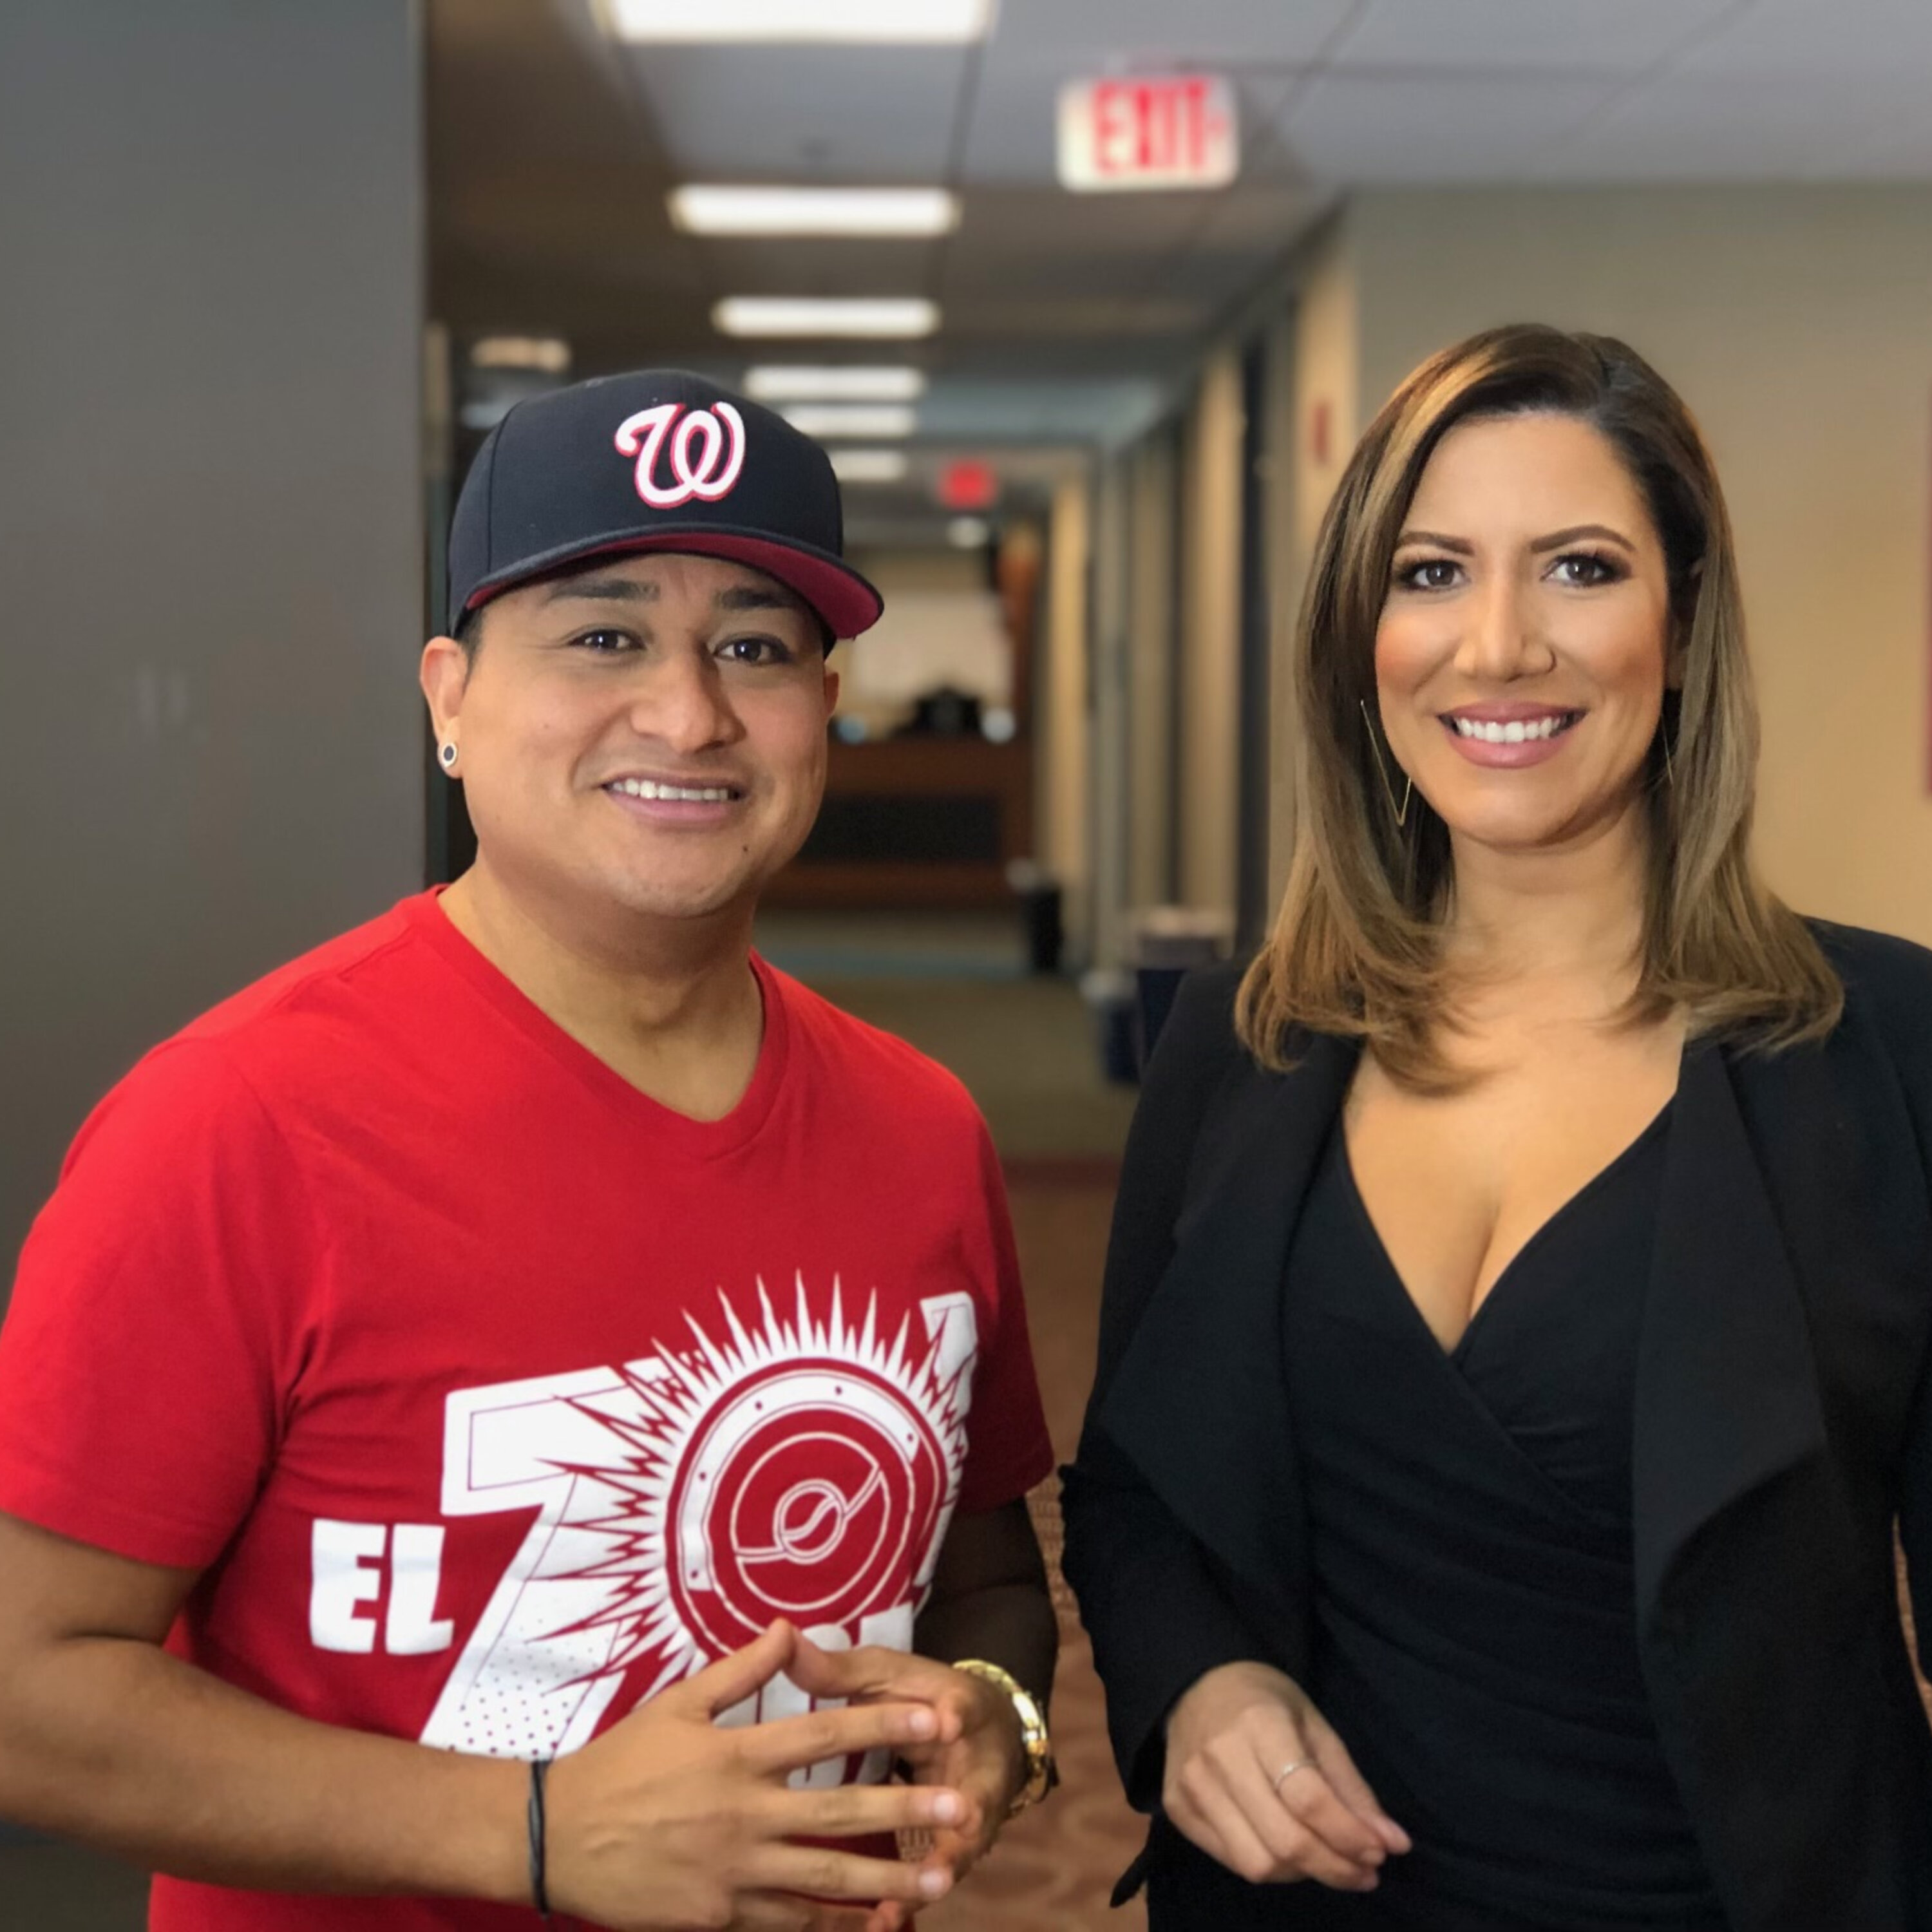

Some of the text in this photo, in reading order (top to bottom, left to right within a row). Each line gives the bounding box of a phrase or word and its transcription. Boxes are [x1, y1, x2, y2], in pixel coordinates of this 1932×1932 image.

[1092, 78, 1214, 175] EXIT
[614, 401, 745, 509] W
[309, 1518, 455, 1655] EL
